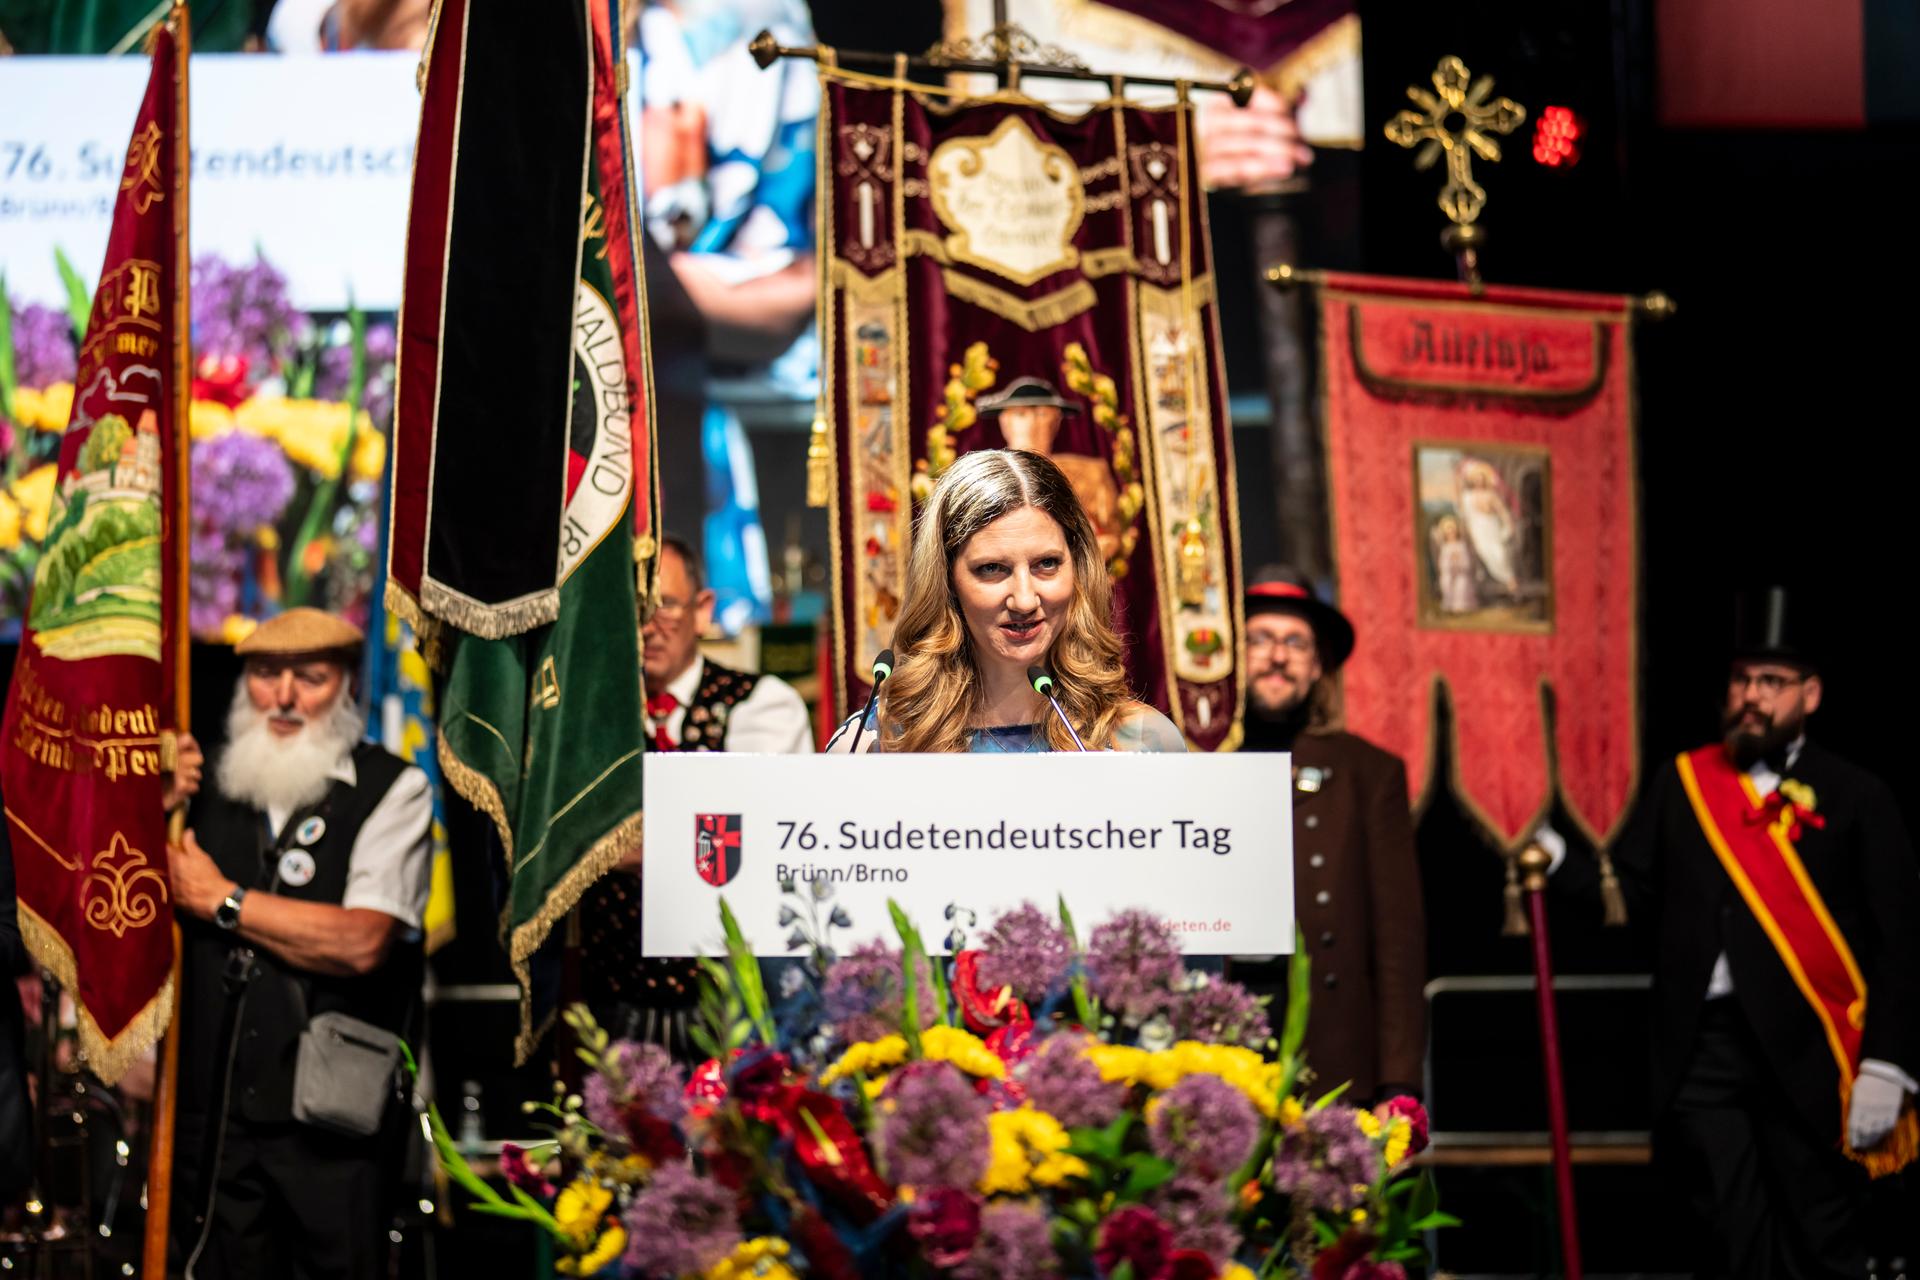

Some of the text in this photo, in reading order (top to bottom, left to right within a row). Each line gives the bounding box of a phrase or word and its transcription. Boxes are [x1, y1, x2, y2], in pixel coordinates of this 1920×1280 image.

[776, 820, 1231, 855] 76. Sudetendeutscher Tag
[776, 863, 909, 883] Brünn/Brno
[1159, 918, 1232, 932] deten.de
